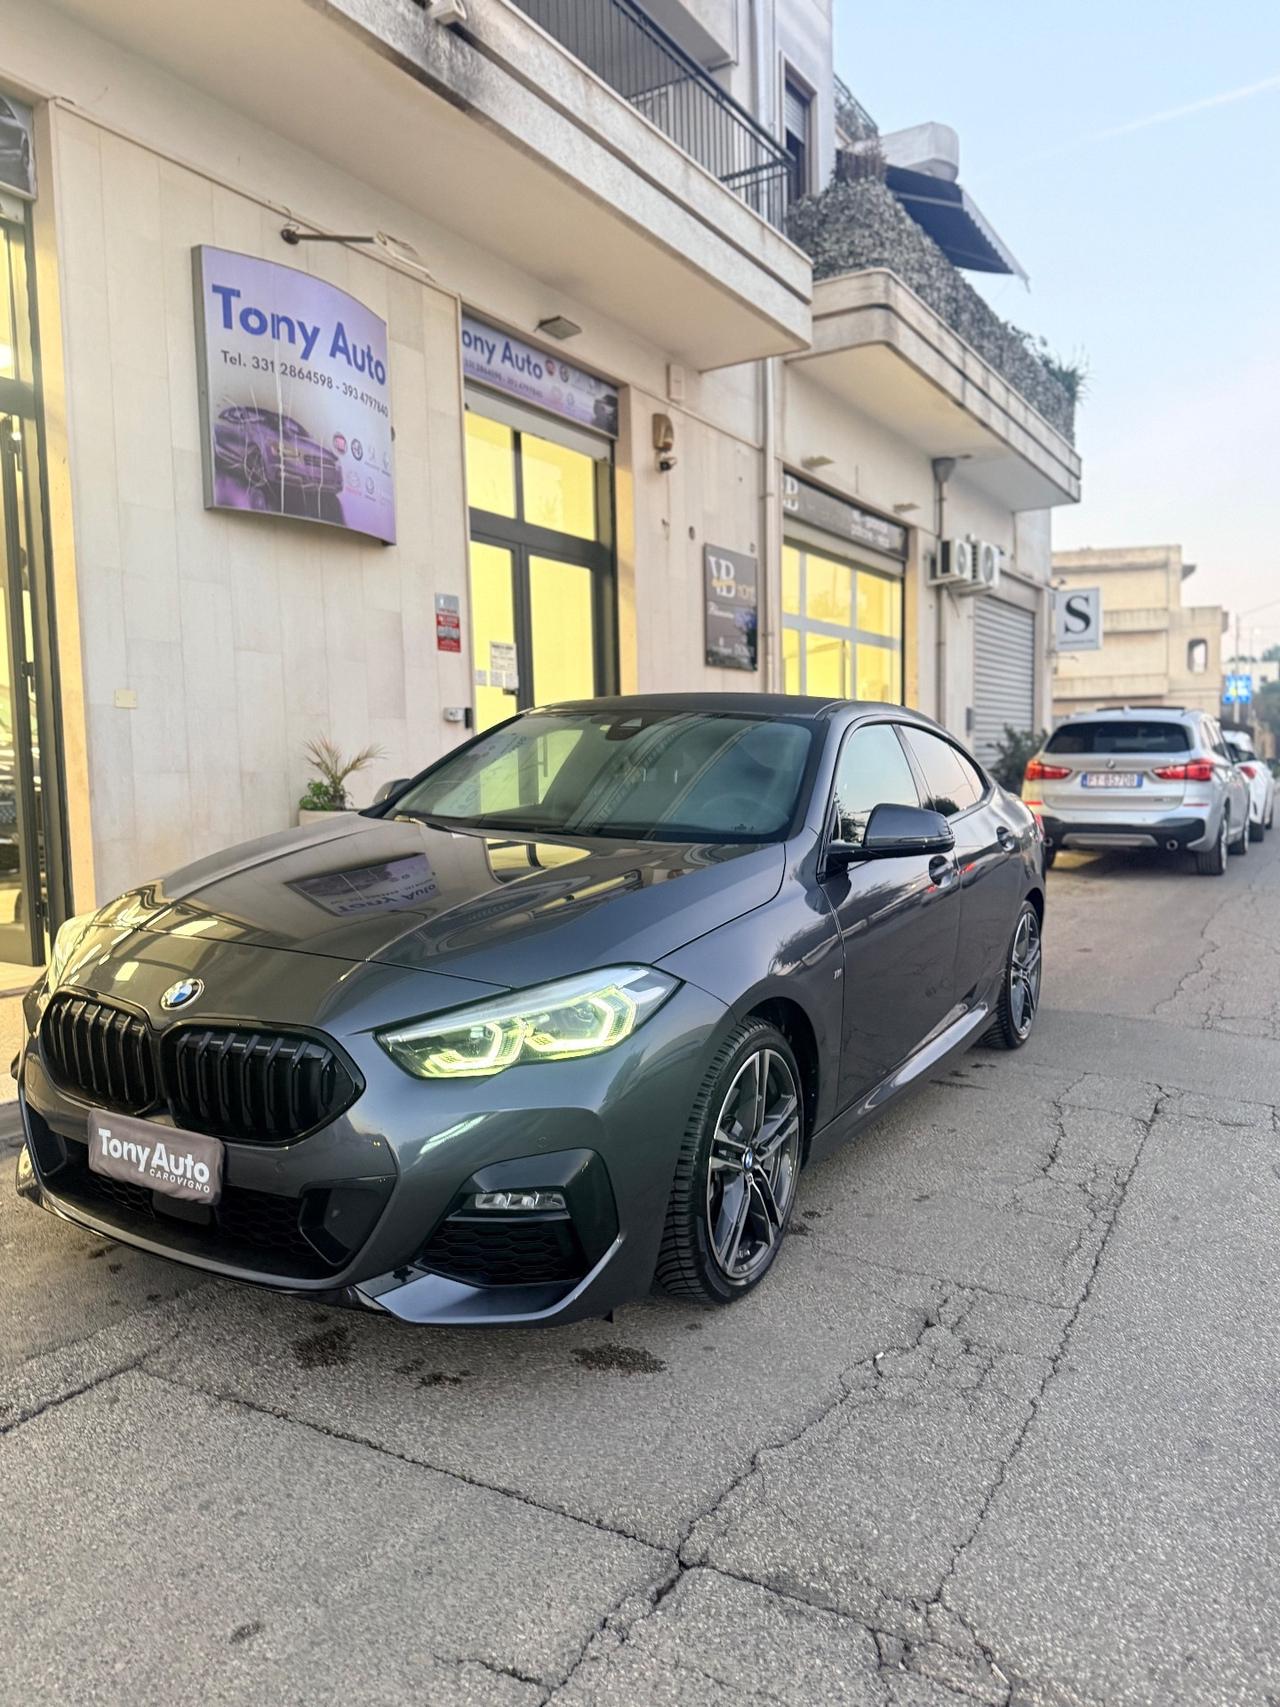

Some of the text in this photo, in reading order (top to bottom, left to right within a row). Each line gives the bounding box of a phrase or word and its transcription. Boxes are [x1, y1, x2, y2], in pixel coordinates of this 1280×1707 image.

[212, 284, 386, 386] Tony Auto
[462, 330, 543, 380] ony Auto
[221, 350, 247, 367] Tel.
[251, 356, 275, 373] 331
[280, 363, 333, 390] 2864598
[342, 382, 359, 400] 393
[1064, 594, 1091, 634] S
[149, 1168, 211, 1194] CAROVIGNO
